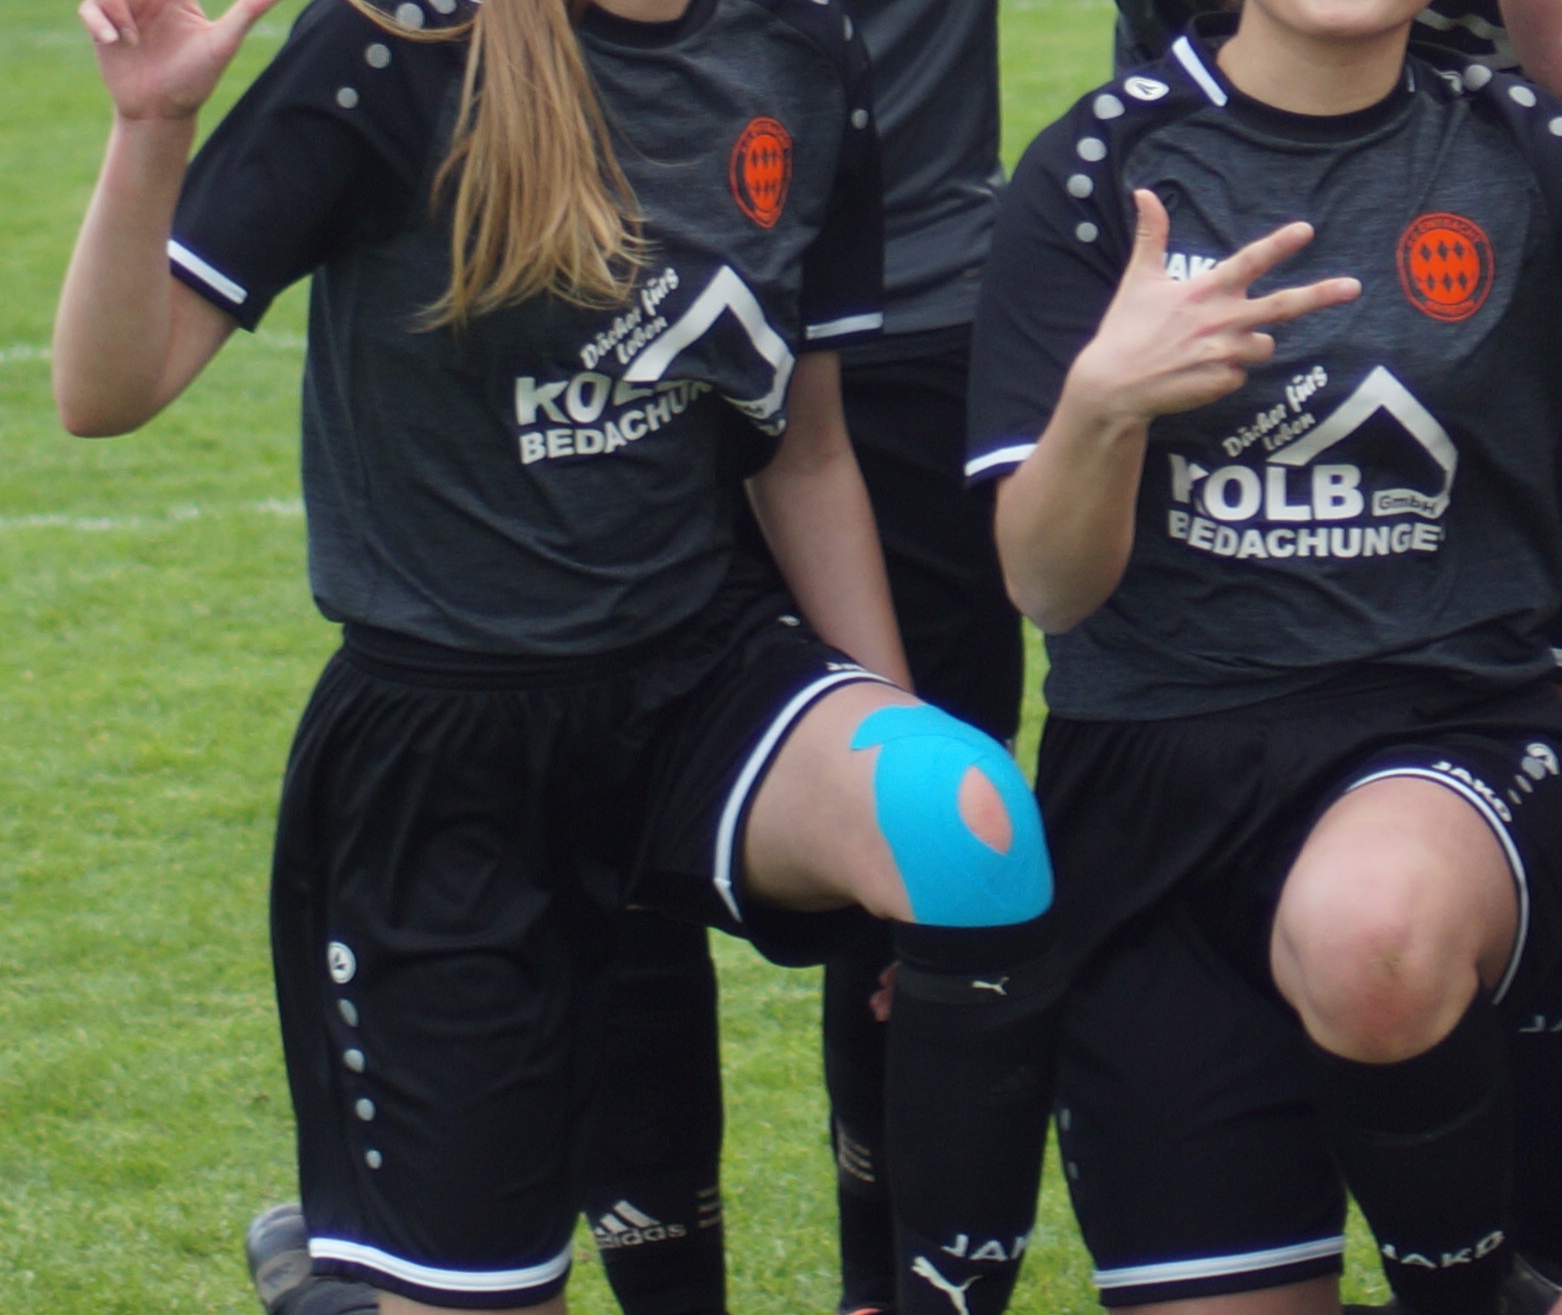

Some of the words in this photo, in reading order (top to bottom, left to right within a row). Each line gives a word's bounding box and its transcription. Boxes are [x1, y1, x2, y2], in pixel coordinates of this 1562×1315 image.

[1377, 493, 1438, 515] GmbH
[1167, 509, 1446, 559] BEDACHUNGE
[1431, 760, 1512, 822] JAKO
[1381, 1230, 1504, 1269] JAKO
